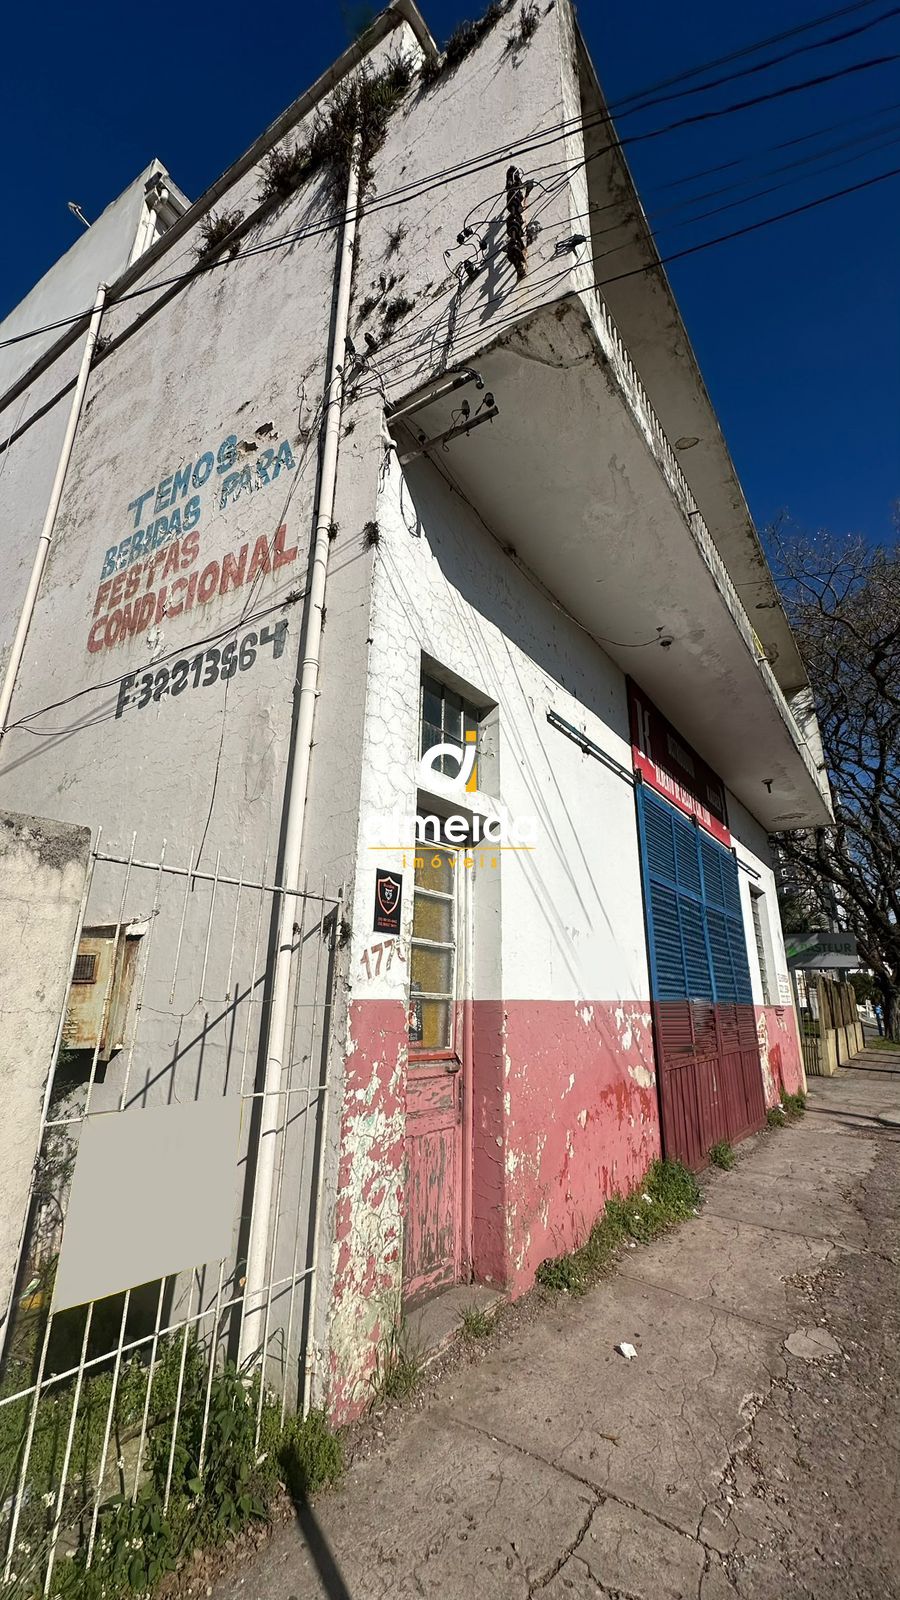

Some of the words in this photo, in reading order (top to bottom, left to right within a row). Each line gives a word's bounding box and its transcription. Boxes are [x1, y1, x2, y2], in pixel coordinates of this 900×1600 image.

[100, 495, 201, 580] BEBIDAS
[218, 439, 297, 511] PARA
[127, 434, 238, 529] TEMOS
[87, 523, 298, 654] CONDICIONAL
[92, 530, 200, 617] FESTAS
